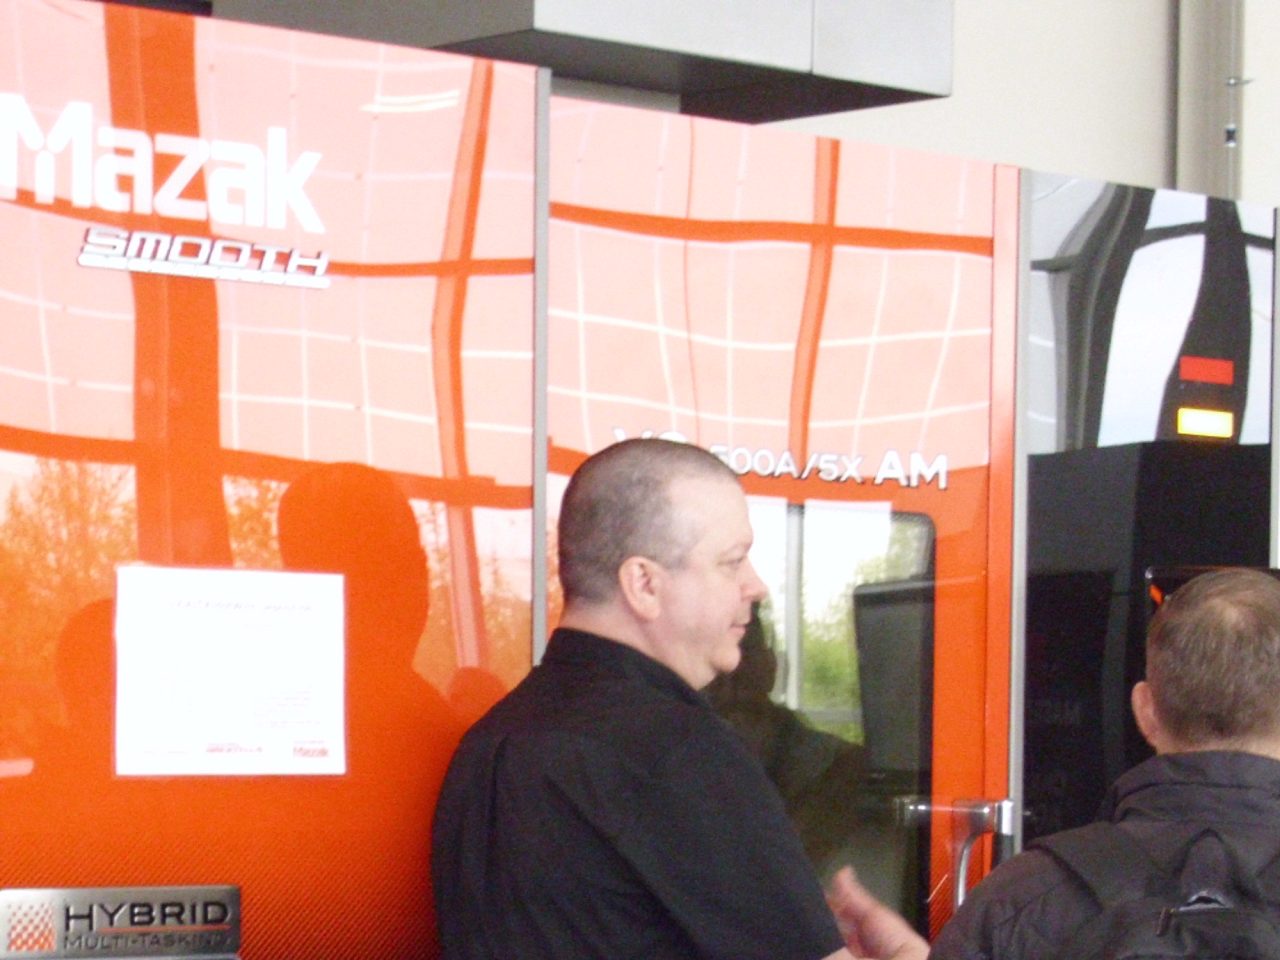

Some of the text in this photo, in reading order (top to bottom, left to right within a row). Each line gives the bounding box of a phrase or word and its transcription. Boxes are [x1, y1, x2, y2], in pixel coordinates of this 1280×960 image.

[0, 92, 326, 233] Mazak
[85, 226, 329, 276] SMOOTH
[874, 450, 947, 490] AM
[65, 900, 230, 932] HYBRID
